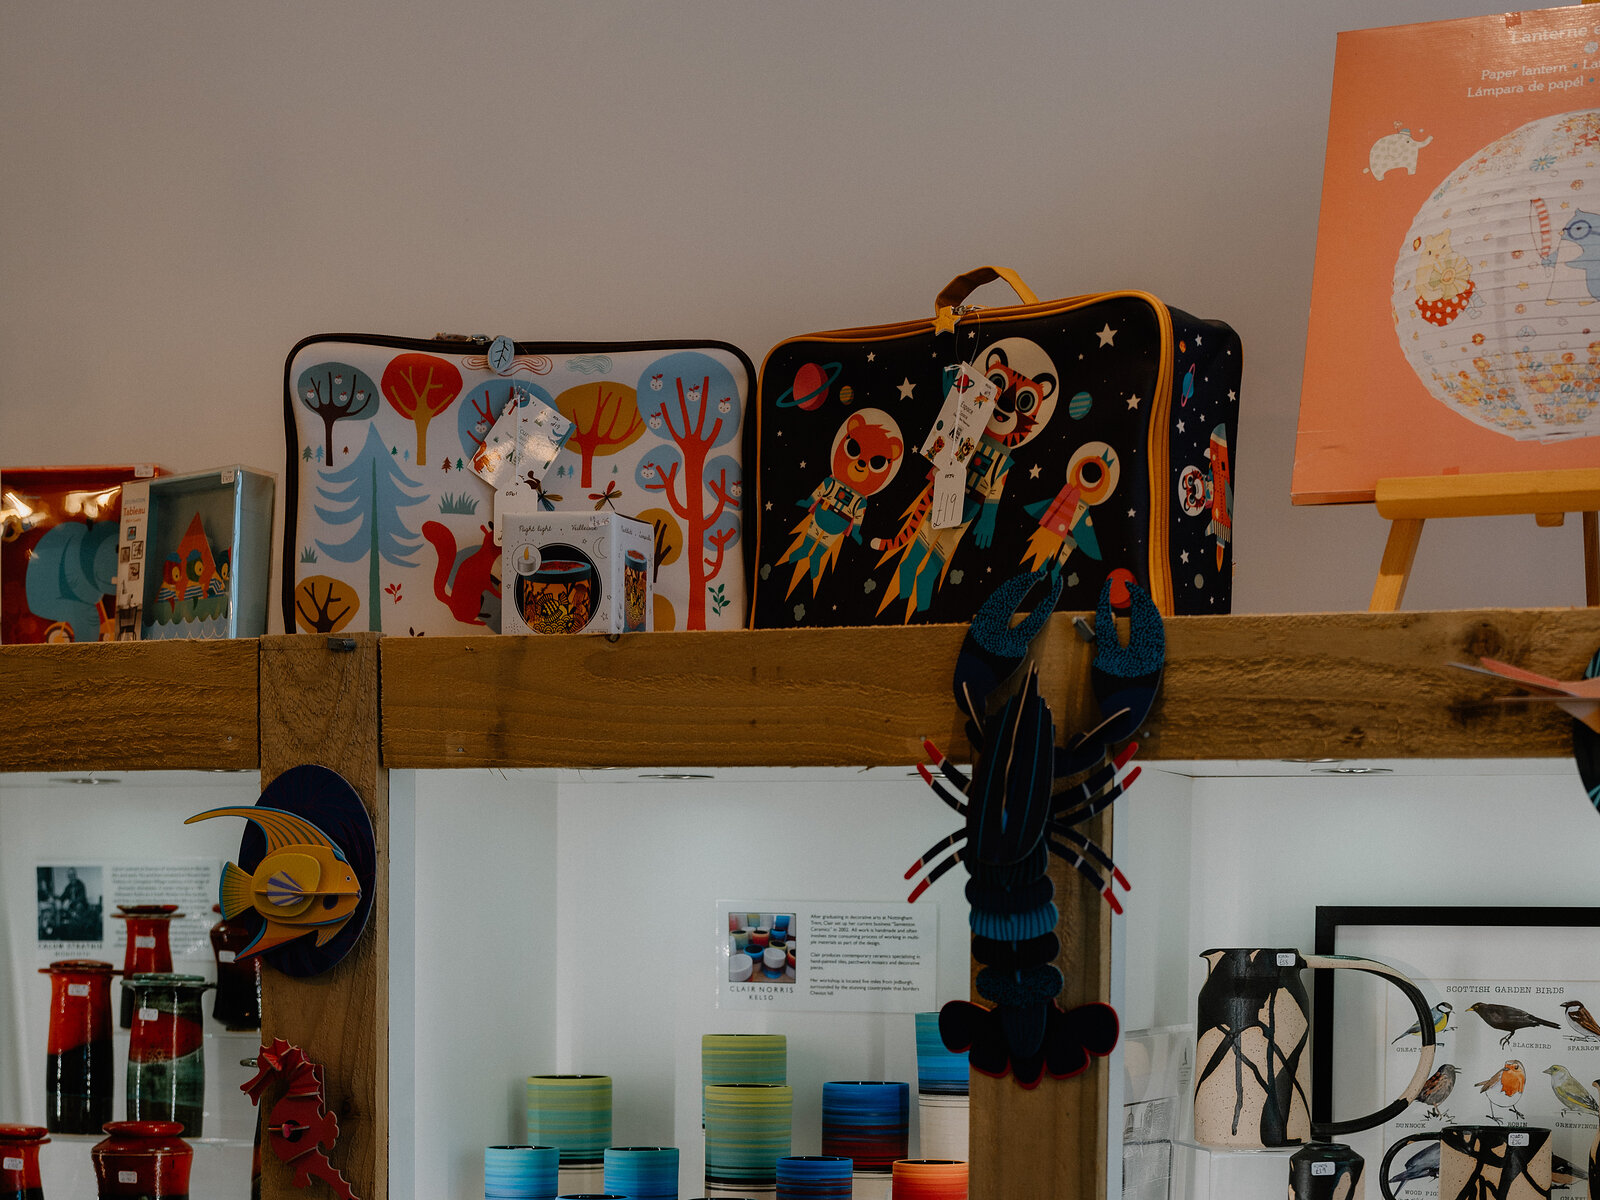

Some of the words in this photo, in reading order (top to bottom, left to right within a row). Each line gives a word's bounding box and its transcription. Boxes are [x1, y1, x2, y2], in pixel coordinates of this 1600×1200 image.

[1511, 26, 1588, 44] Lanterne
[1481, 69, 1518, 82] Paper
[1521, 64, 1568, 76] lantern
[1467, 85, 1524, 98] Lámpara
[1528, 80, 1544, 92] de
[1548, 75, 1584, 92] papél
[123, 507, 146, 517] Tableau
[933, 491, 958, 528] £19
[518, 524, 536, 536] Night
[536, 525, 552, 536] light
[759, 986, 794, 994] NORRIS
[1446, 985, 1490, 994] SCOTTISH
[1494, 986, 1532, 994] GARDEN
[1535, 986, 1565, 994] BIRDS
[1512, 1042, 1552, 1050] BLACKBIRD
[1555, 1121, 1598, 1130] GREENFINCH
